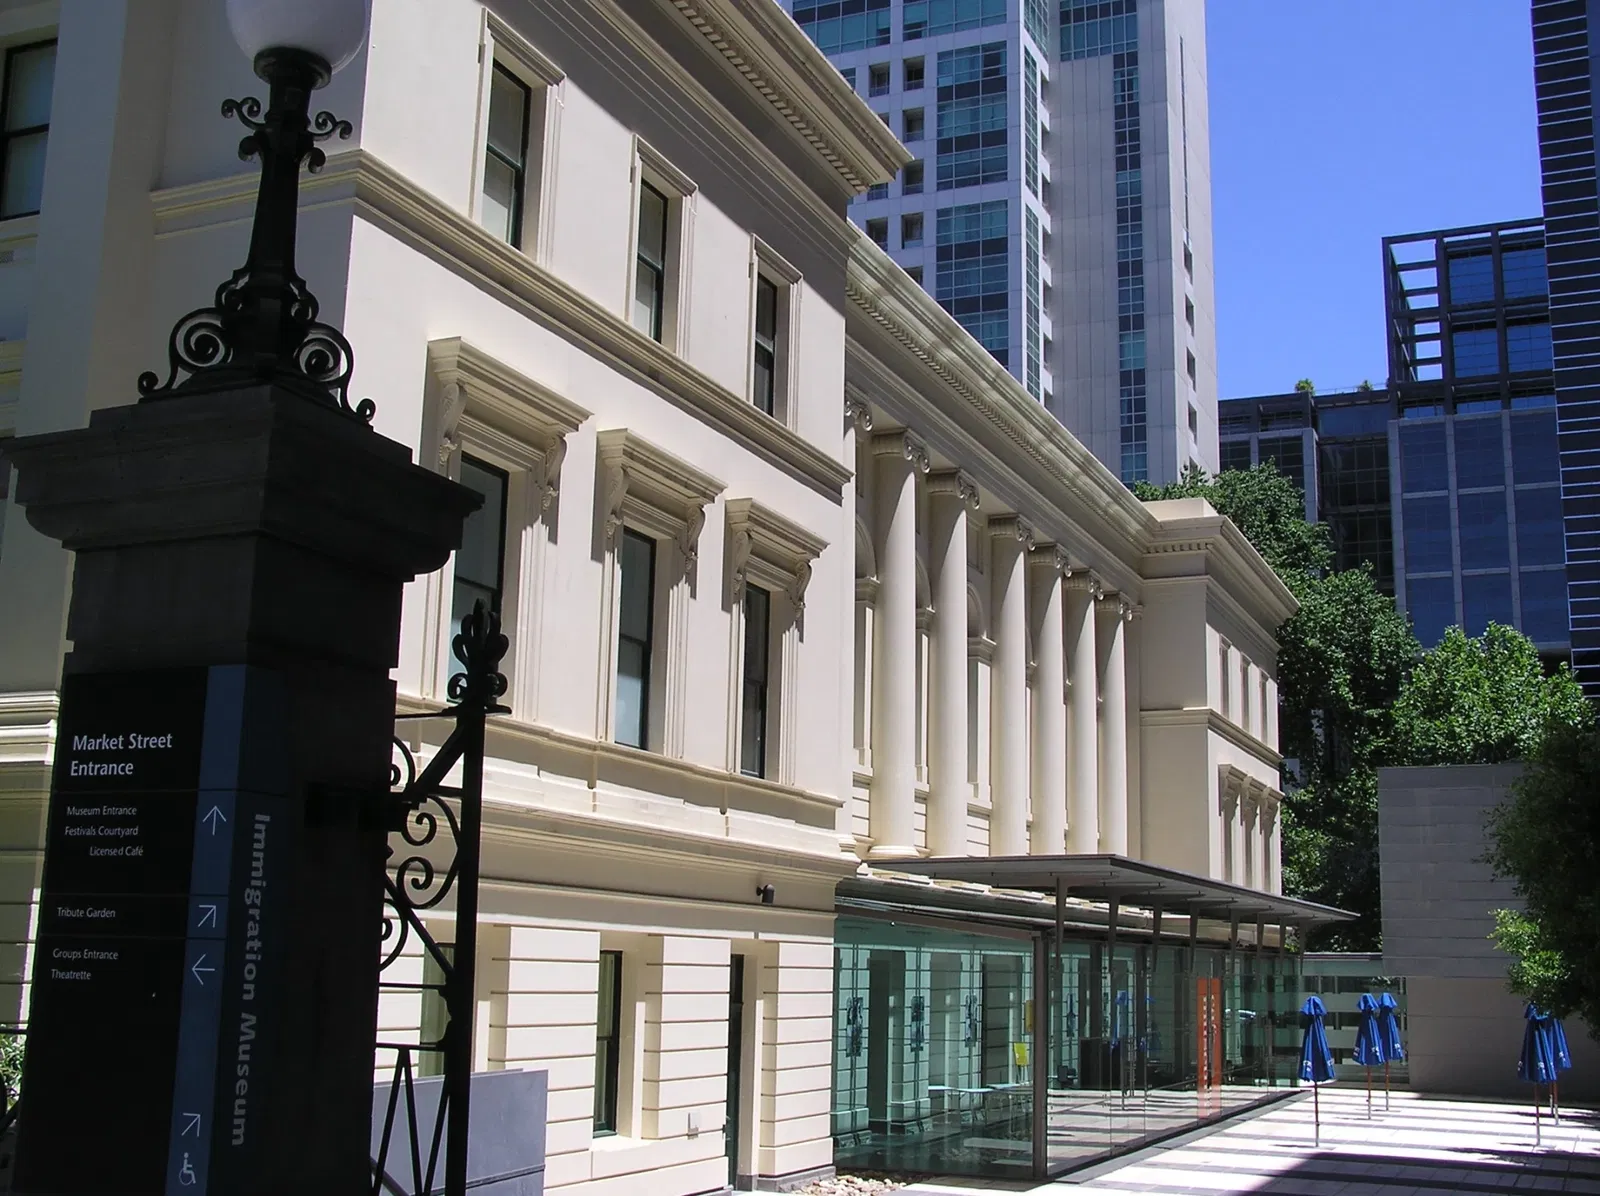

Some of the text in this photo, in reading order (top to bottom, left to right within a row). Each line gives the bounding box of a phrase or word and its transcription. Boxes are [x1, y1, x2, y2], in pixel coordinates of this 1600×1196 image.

[72, 732, 174, 751] Market Street
[70, 760, 135, 777] Entrance
[66, 805, 138, 816] Museum Entrance
[64, 825, 139, 839] Festivals Courtyard
[89, 845, 144, 857] Licensed Café
[57, 906, 116, 918] Tribute Garden
[52, 948, 119, 961] Groups Entrance
[51, 968, 92, 981] Theatrette
[231, 813, 271, 1146] Immigration Museum
